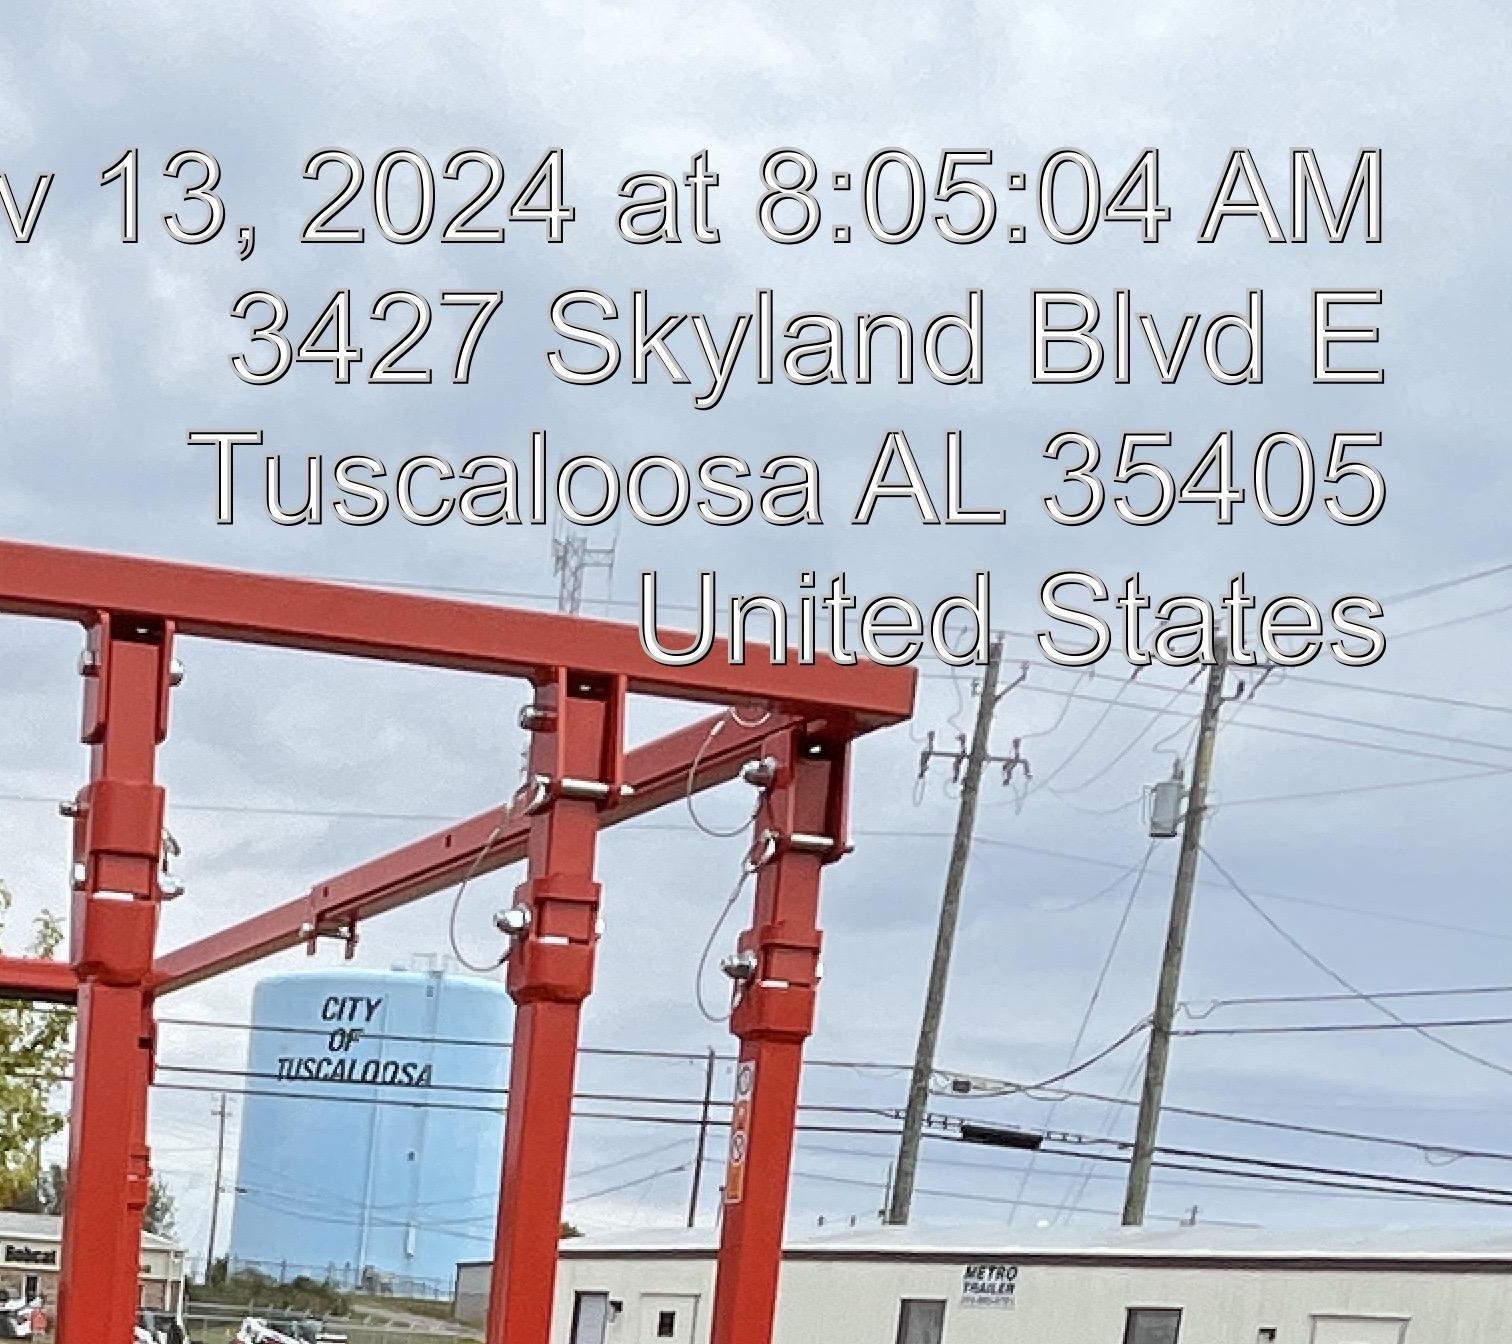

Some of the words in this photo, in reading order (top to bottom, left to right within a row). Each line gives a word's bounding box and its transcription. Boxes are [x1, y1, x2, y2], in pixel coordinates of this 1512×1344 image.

[320, 996, 384, 1022] CITY
[327, 1026, 366, 1052] OF
[277, 1056, 433, 1087] TUSCALOOSA
[963, 1265, 1018, 1281] METRO
